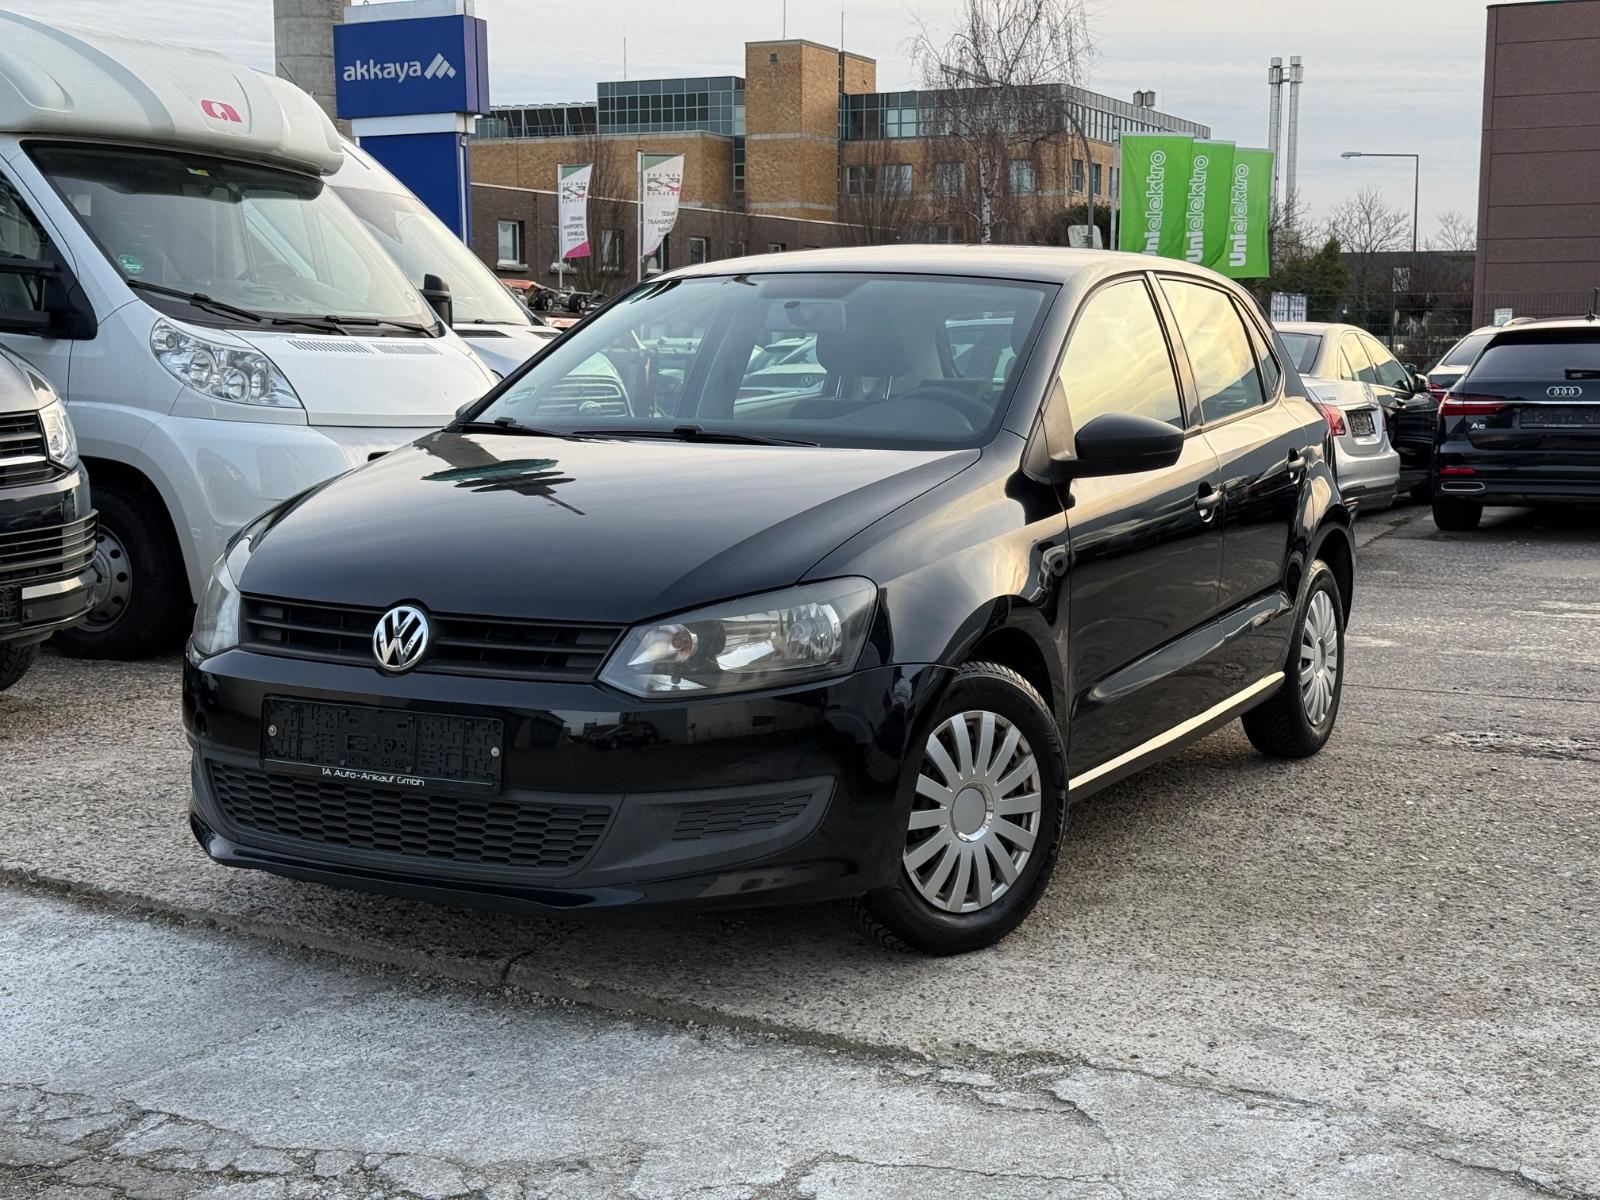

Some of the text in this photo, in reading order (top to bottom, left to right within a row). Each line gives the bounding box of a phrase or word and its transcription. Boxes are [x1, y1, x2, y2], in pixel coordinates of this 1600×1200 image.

[343, 59, 422, 83] akkaya
[1185, 155, 1209, 263] Unielektro
[1229, 163, 1249, 267] Unielektro
